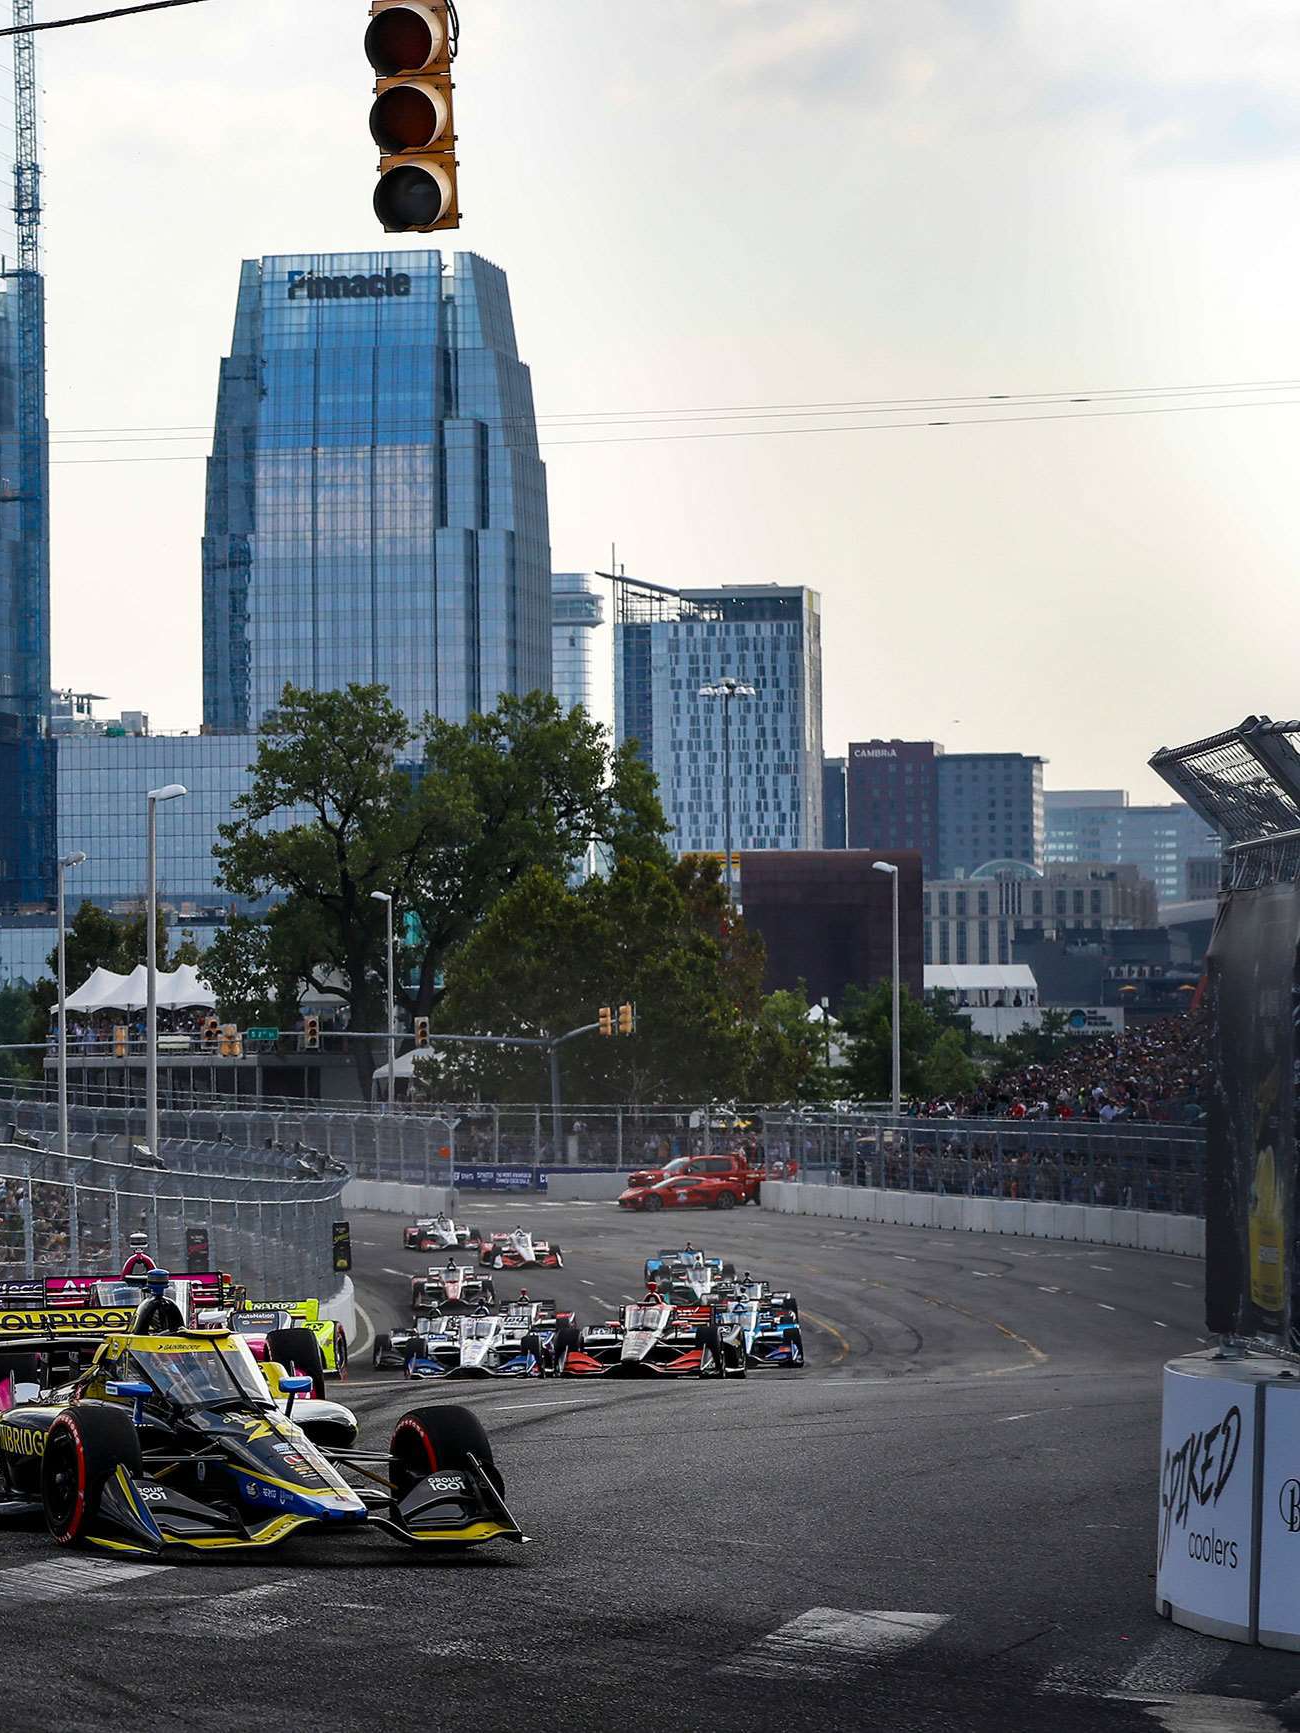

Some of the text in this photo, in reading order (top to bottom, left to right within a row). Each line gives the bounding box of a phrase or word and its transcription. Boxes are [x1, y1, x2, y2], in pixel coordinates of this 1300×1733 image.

[287, 267, 411, 300] Pinnacle
[854, 748, 897, 758] CAMBRIA
[237, 1312, 276, 1320] AutoNation
[427, 1476, 462, 1484] GROUP
[428, 1481, 467, 1491] 1001
[1157, 1405, 1242, 1572] SPIKED
[1188, 1527, 1239, 1569] coolers
